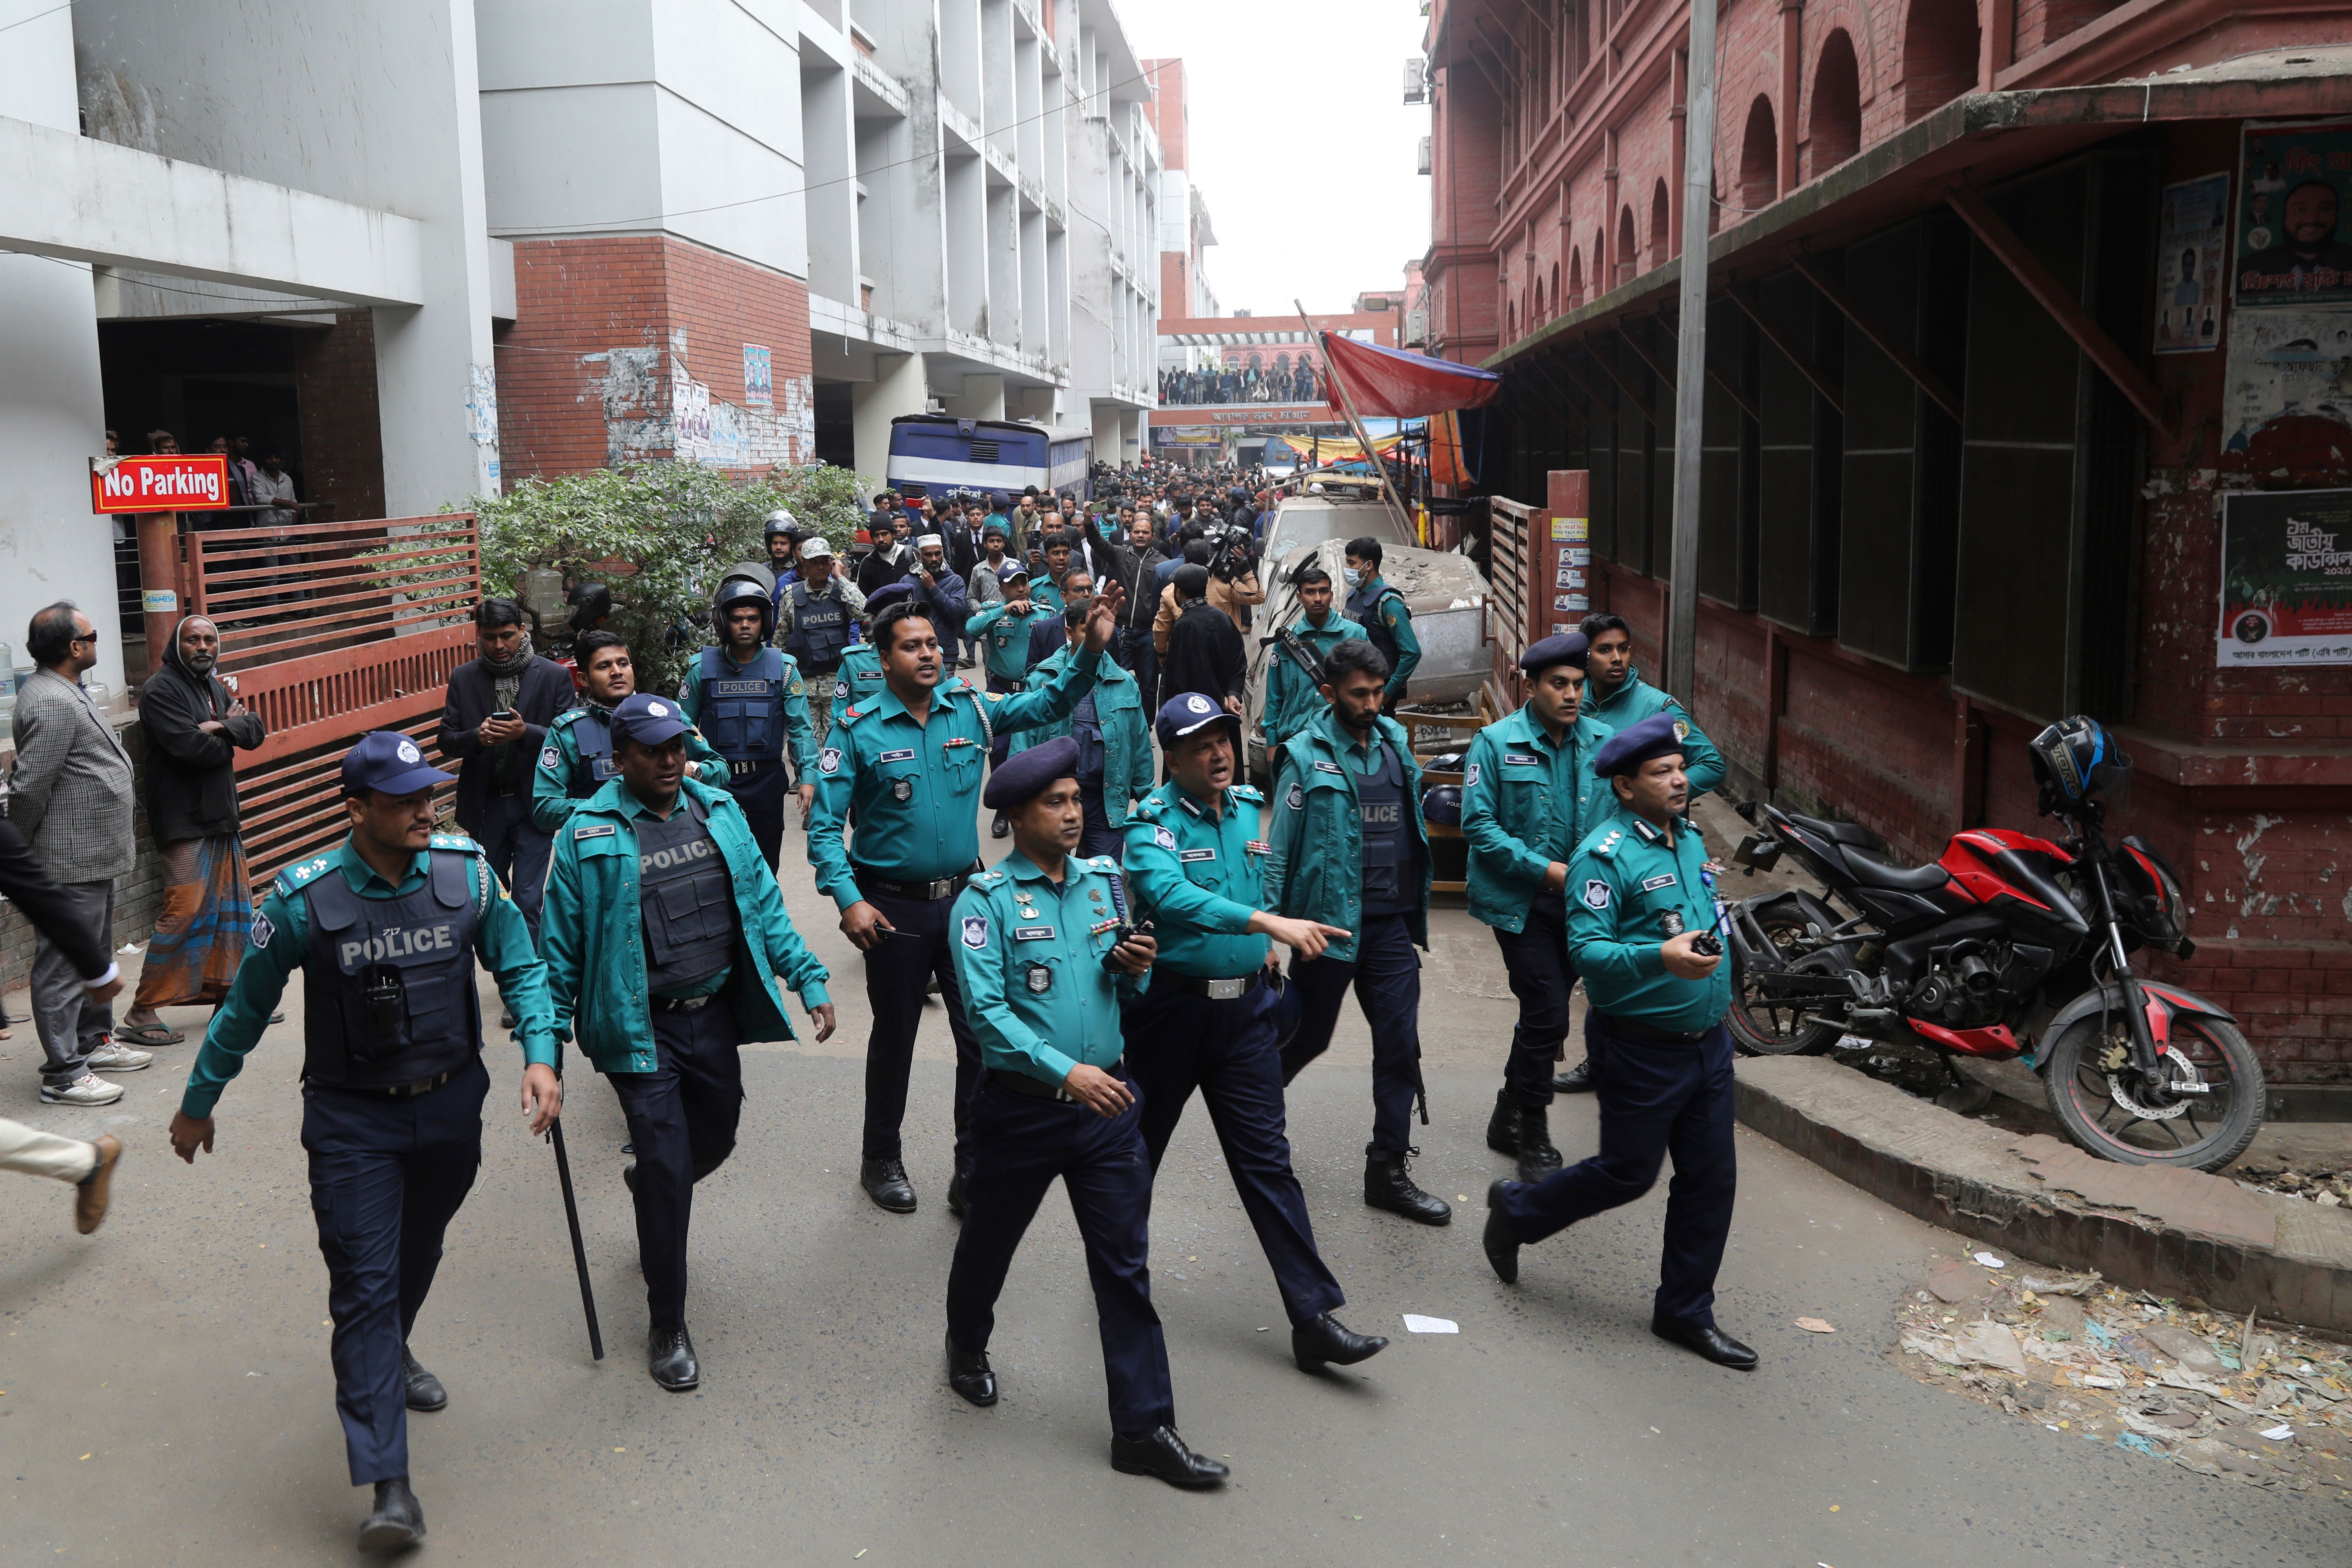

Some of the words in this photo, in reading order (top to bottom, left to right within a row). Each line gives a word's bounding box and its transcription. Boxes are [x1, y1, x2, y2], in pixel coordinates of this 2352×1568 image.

[2285, 147, 2321, 175] কিং
[2242, 271, 2298, 290] নিঃশর্ত
[2302, 267, 2340, 291] মুক্তি
[1212, 412, 1250, 422] আদালত
[1279, 409, 1310, 420] চট্টগ্রাম
[104, 467, 134, 497] No
[140, 466, 219, 501] Parking
[946, 486, 981, 499] পলিশ
[2287, 517, 2310, 535] ১ম
[2286, 527, 2339, 552] জাতীয়
[2286, 548, 2352, 570] কাউন্সিল
[2324, 567, 2352, 575] ২০২৫
[802, 612, 841, 625] POLICE
[1342, 610, 1360, 623] POLICE
[2257, 650, 2292, 658] বাংলাদেশ
[2295, 647, 2310, 658] পার্টি
[2312, 648, 2330, 658] (এবি
[2333, 647, 2352, 658] পার্টি)
[723, 683, 761, 692] POLICE
[1362, 806, 1398, 822] LICE
[640, 837, 721, 874] POLICE
[342, 925, 453, 966] POLICE
